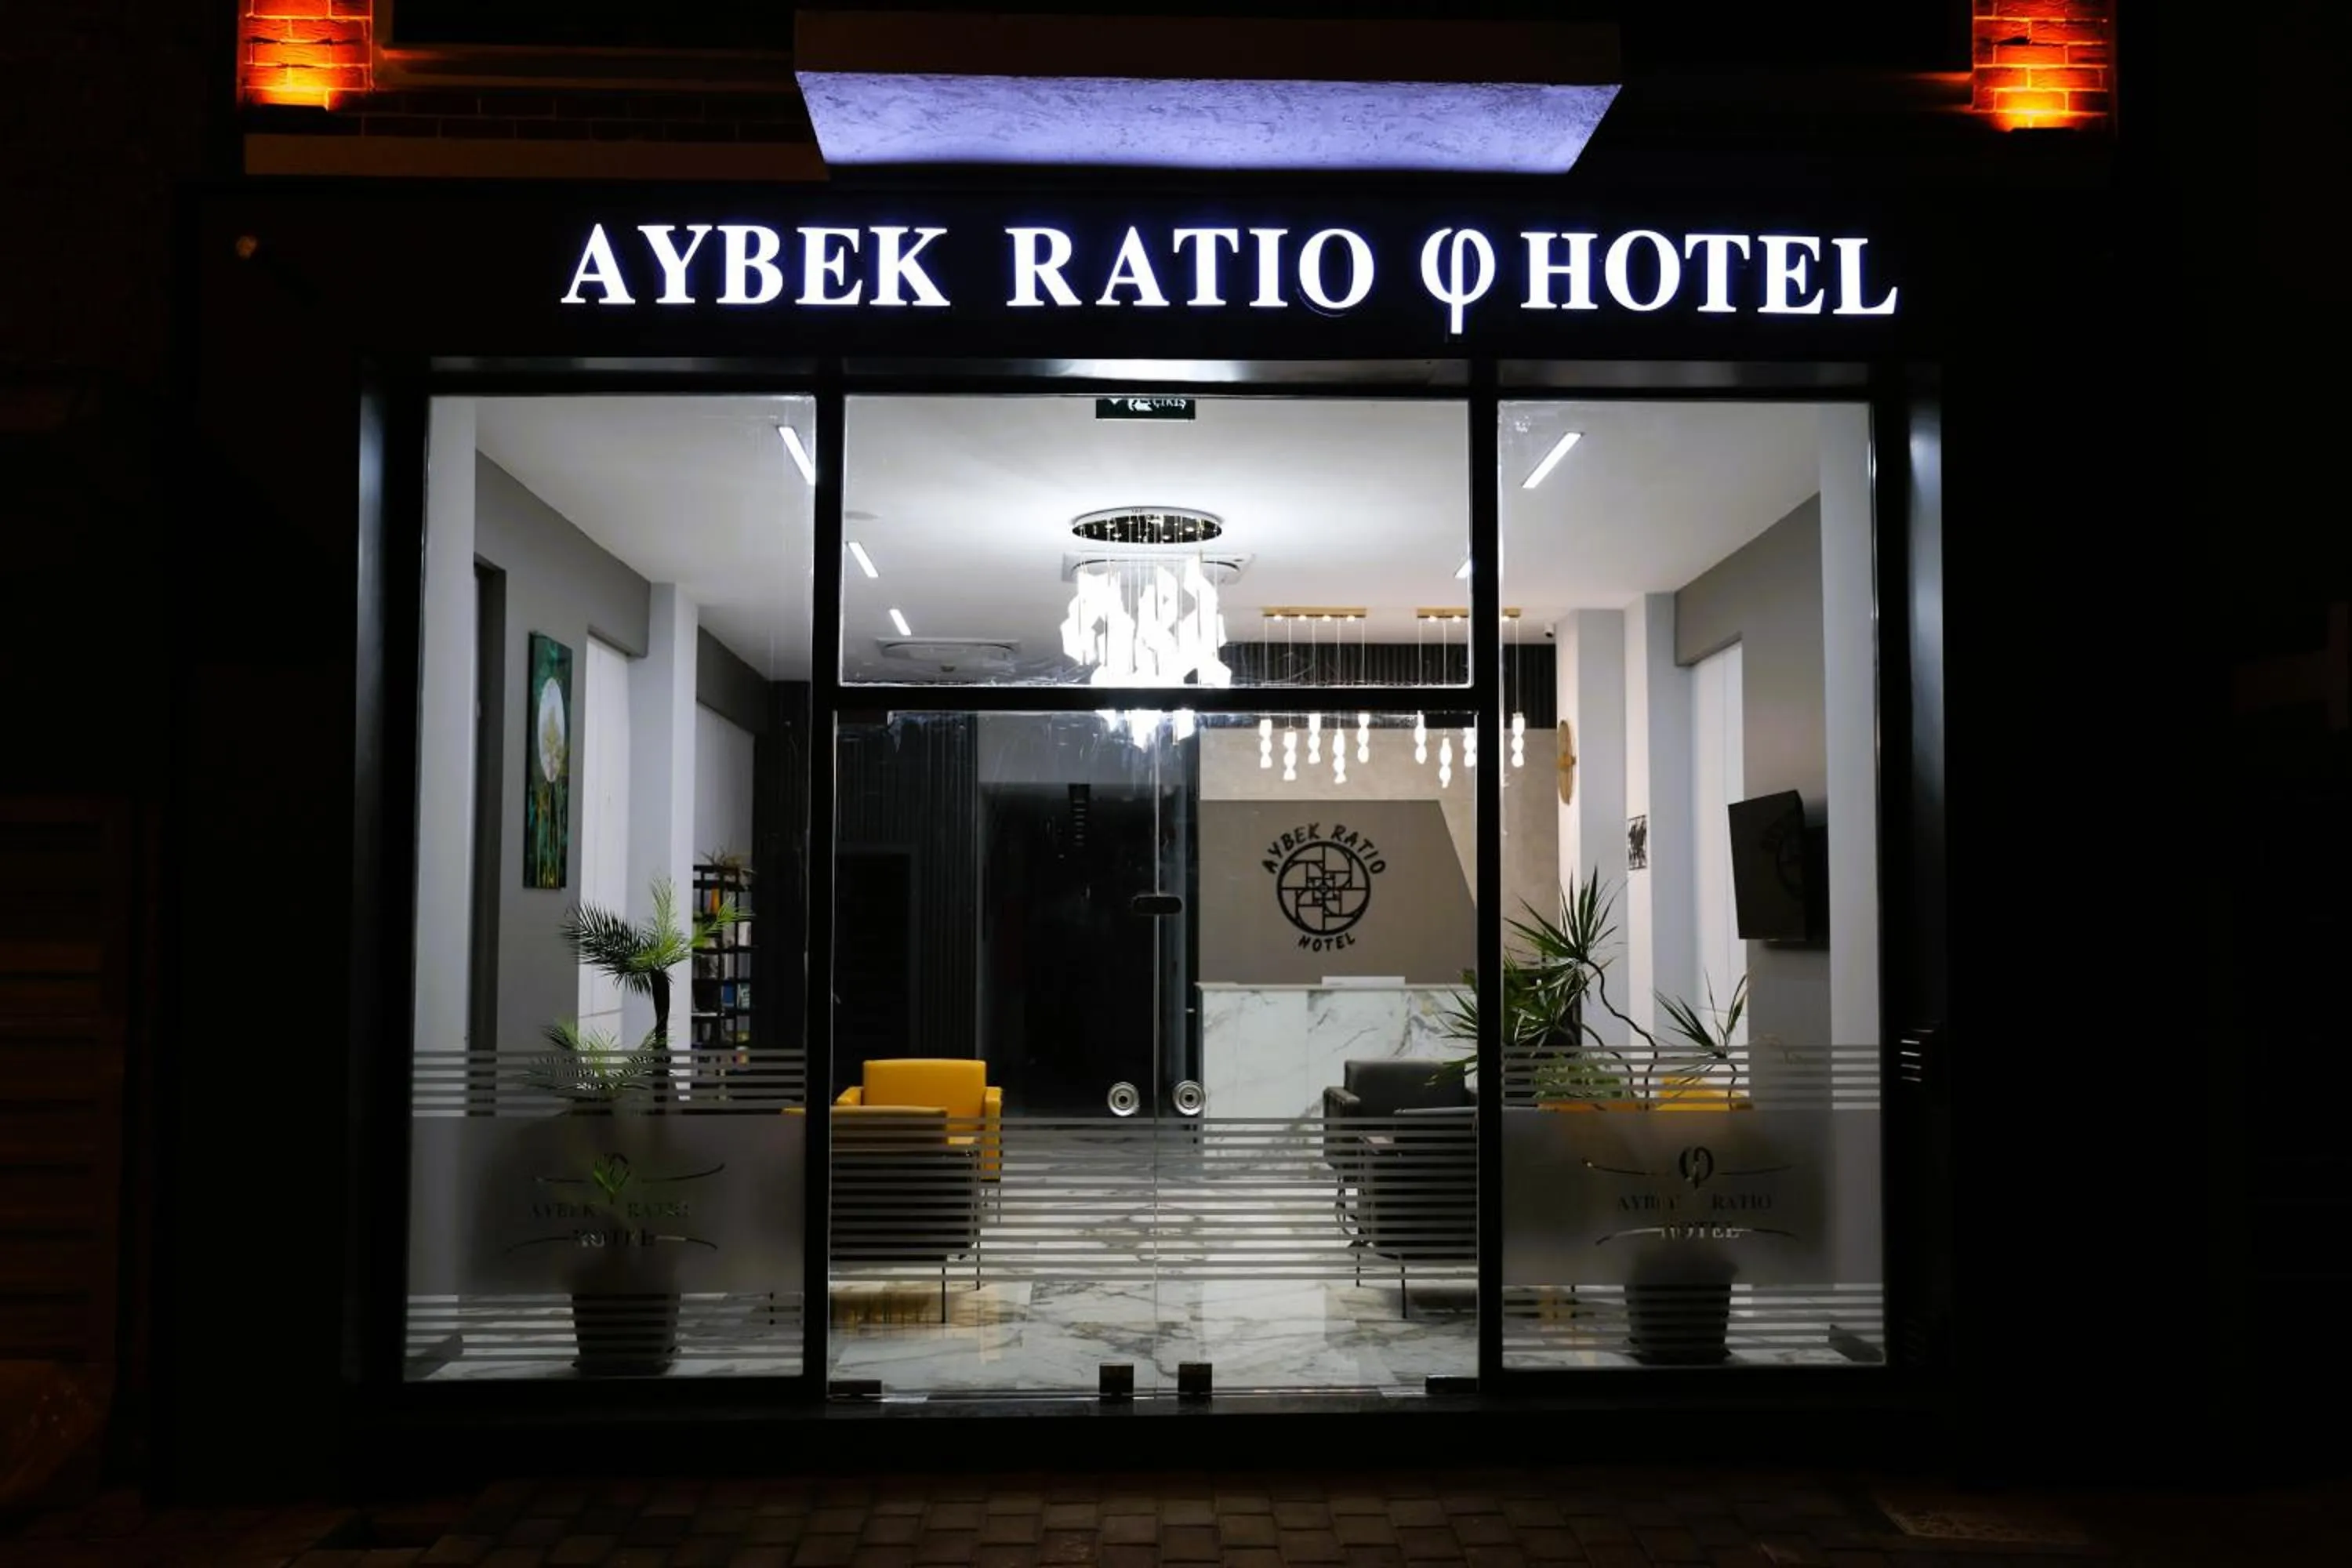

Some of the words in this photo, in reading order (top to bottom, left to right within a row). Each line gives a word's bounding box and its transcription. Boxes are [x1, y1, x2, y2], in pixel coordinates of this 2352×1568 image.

[561, 223, 951, 307] AYBEK
[1004, 226, 1374, 309] RATIO
[1520, 230, 1898, 314] HOTEL
[1261, 822, 1320, 874] AYBEK
[1330, 824, 1387, 875] RATIO
[1298, 931, 1356, 953] HOTEL
